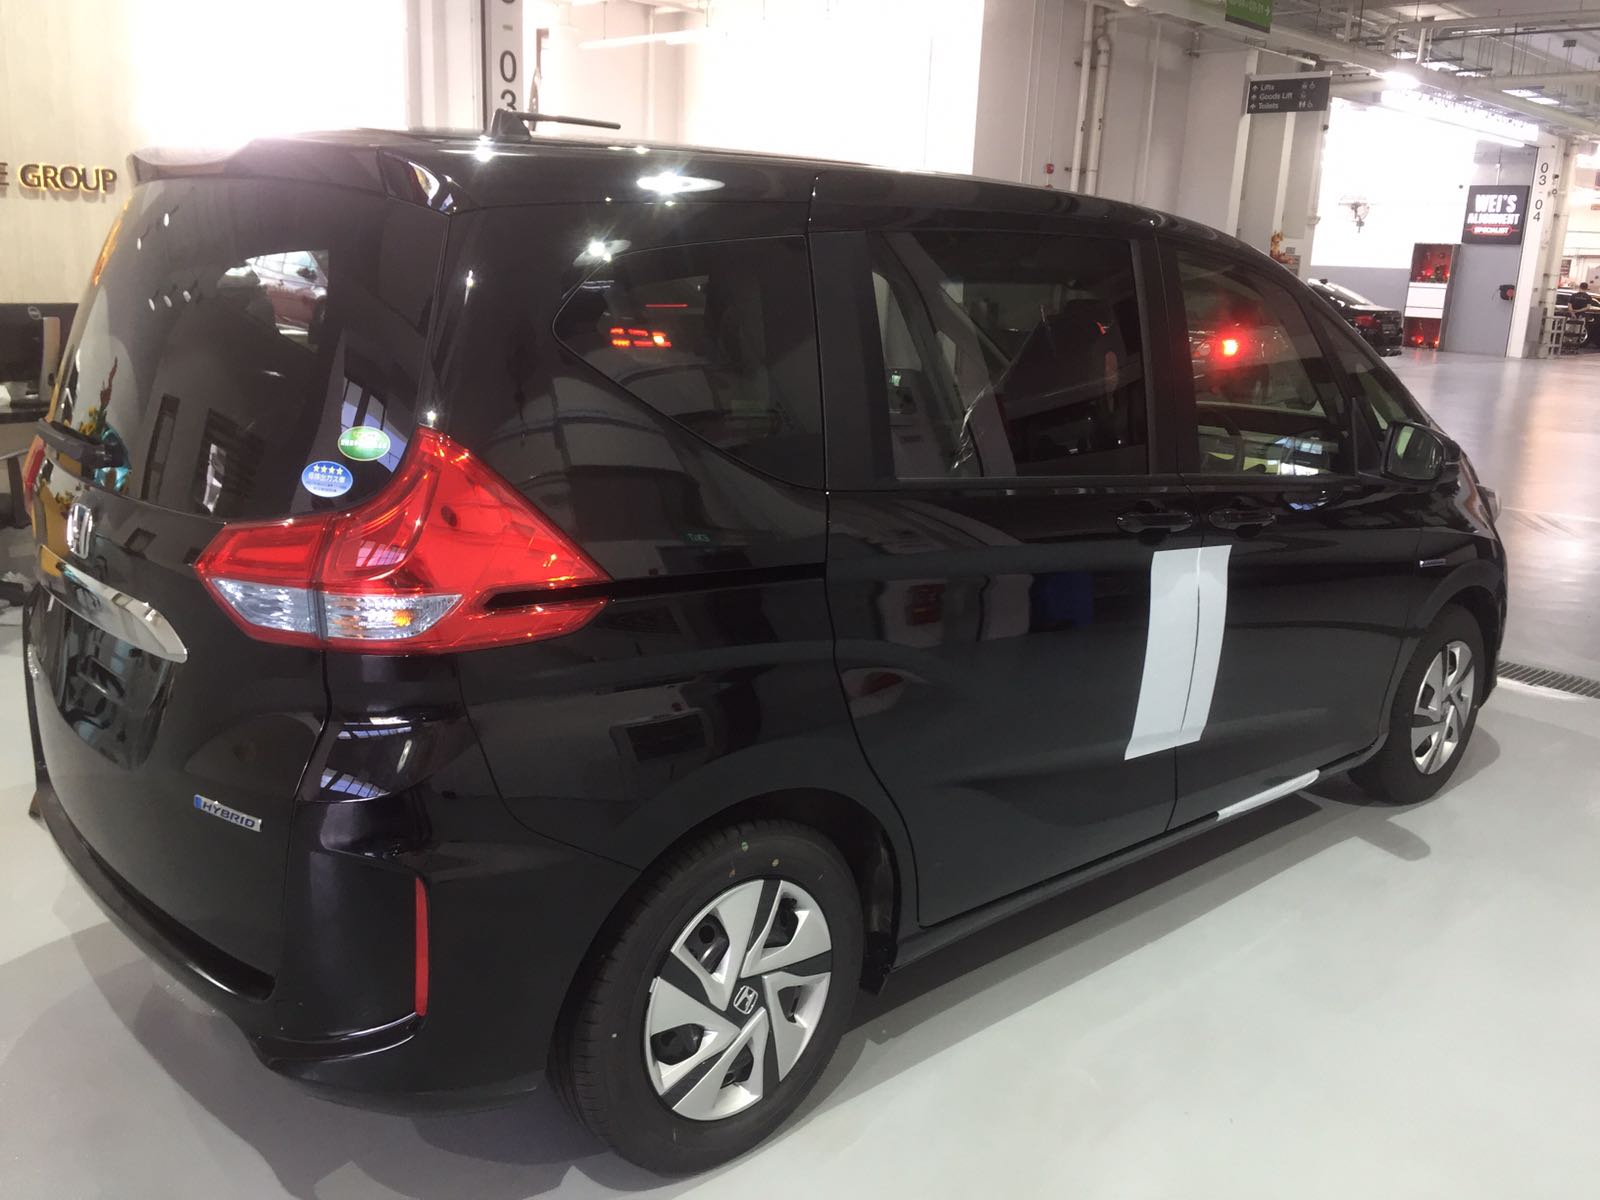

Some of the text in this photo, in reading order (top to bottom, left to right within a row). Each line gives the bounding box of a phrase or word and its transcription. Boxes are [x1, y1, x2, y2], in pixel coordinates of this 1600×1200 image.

[1259, 91, 1293, 100] Goods Lift
[20, 164, 118, 191] GROUP
[1475, 194, 1518, 213] WEI'S
[203, 802, 256, 828] HYBRID
